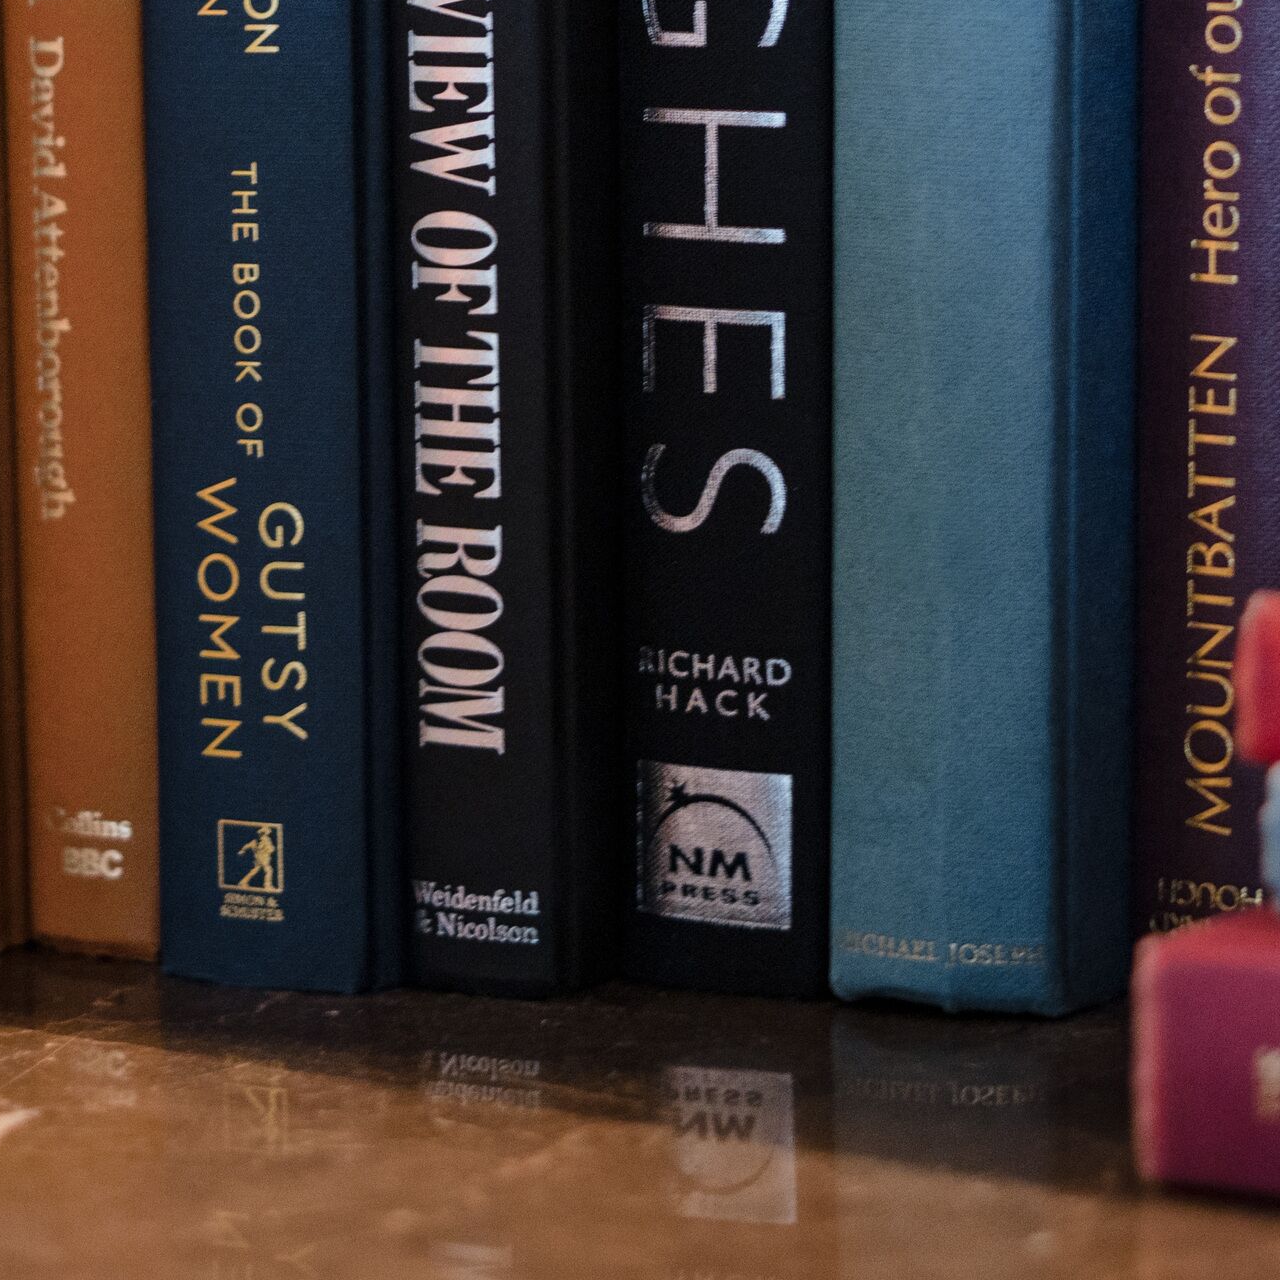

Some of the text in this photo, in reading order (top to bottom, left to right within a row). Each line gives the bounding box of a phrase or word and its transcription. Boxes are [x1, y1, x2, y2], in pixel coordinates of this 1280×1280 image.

[1189, 64, 1242, 125] of
[411, 210, 499, 316] OF
[1190, 141, 1240, 284] Hero
[29, 36, 76, 520] David Attenborough
[231, 161, 265, 458] THE BOOK OF
[414, 330, 502, 499] THE
[196, 477, 243, 759] WOMEN
[258, 501, 308, 741] GUTSY
[416, 518, 506, 755] ROOM
[1184, 334, 1238, 836] MOUNTBATTEN
[638, 645, 792, 687] RICHARD
[656, 684, 771, 721] HACK
[63, 846, 124, 879] BBC
[412, 879, 541, 916] Weidenfeld
[660, 880, 761, 907] PRESS
[669, 843, 753, 883] NM
[437, 912, 540, 945] Nicolson
